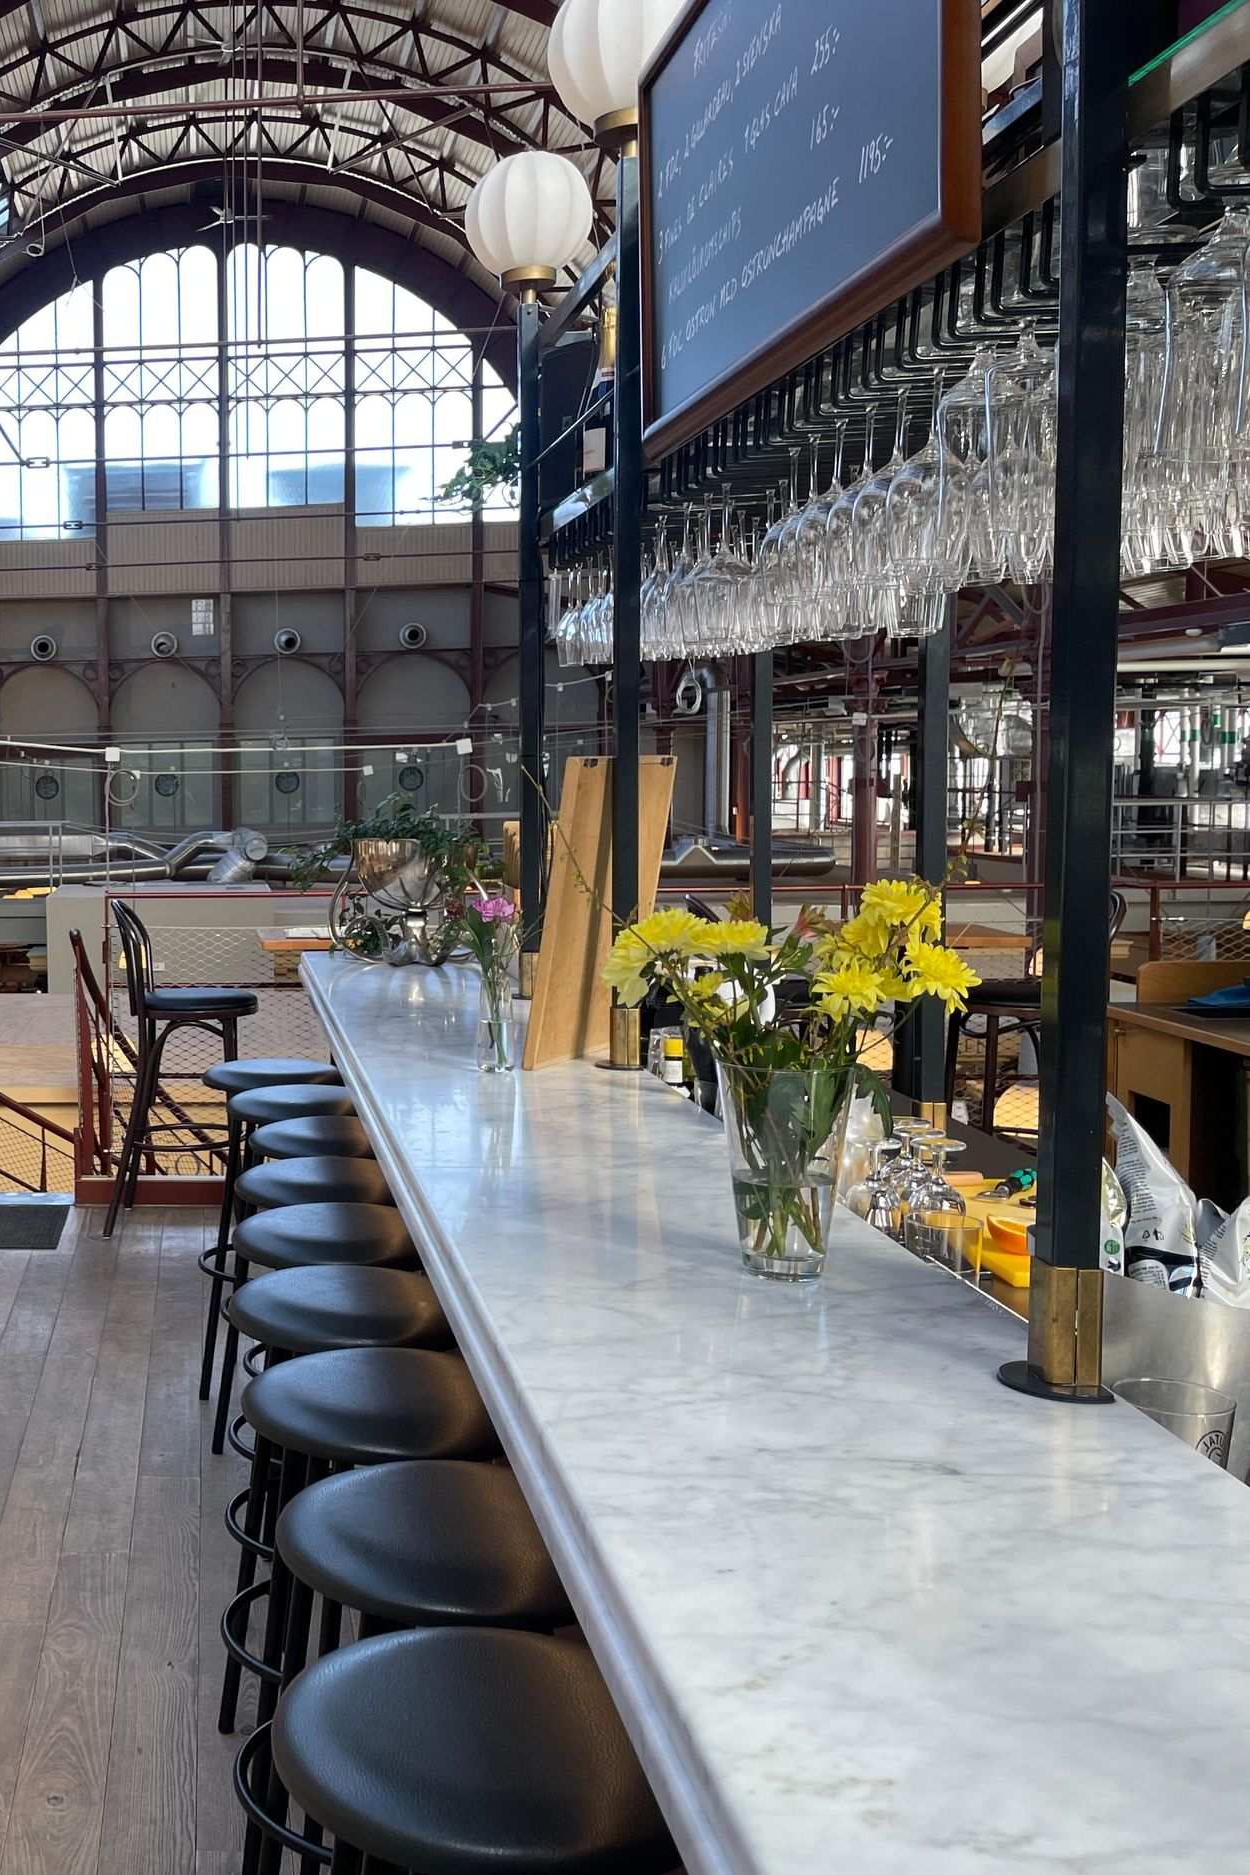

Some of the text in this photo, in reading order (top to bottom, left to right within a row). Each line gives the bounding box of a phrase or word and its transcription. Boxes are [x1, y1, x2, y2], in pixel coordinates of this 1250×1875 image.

[742, 3, 781, 77] SVENSKA
[699, 147, 733, 207] CLAIRES
[750, 102, 770, 150] GLAS
[774, 66, 798, 116] CAVA
[686, 294, 716, 341] OSTRON
